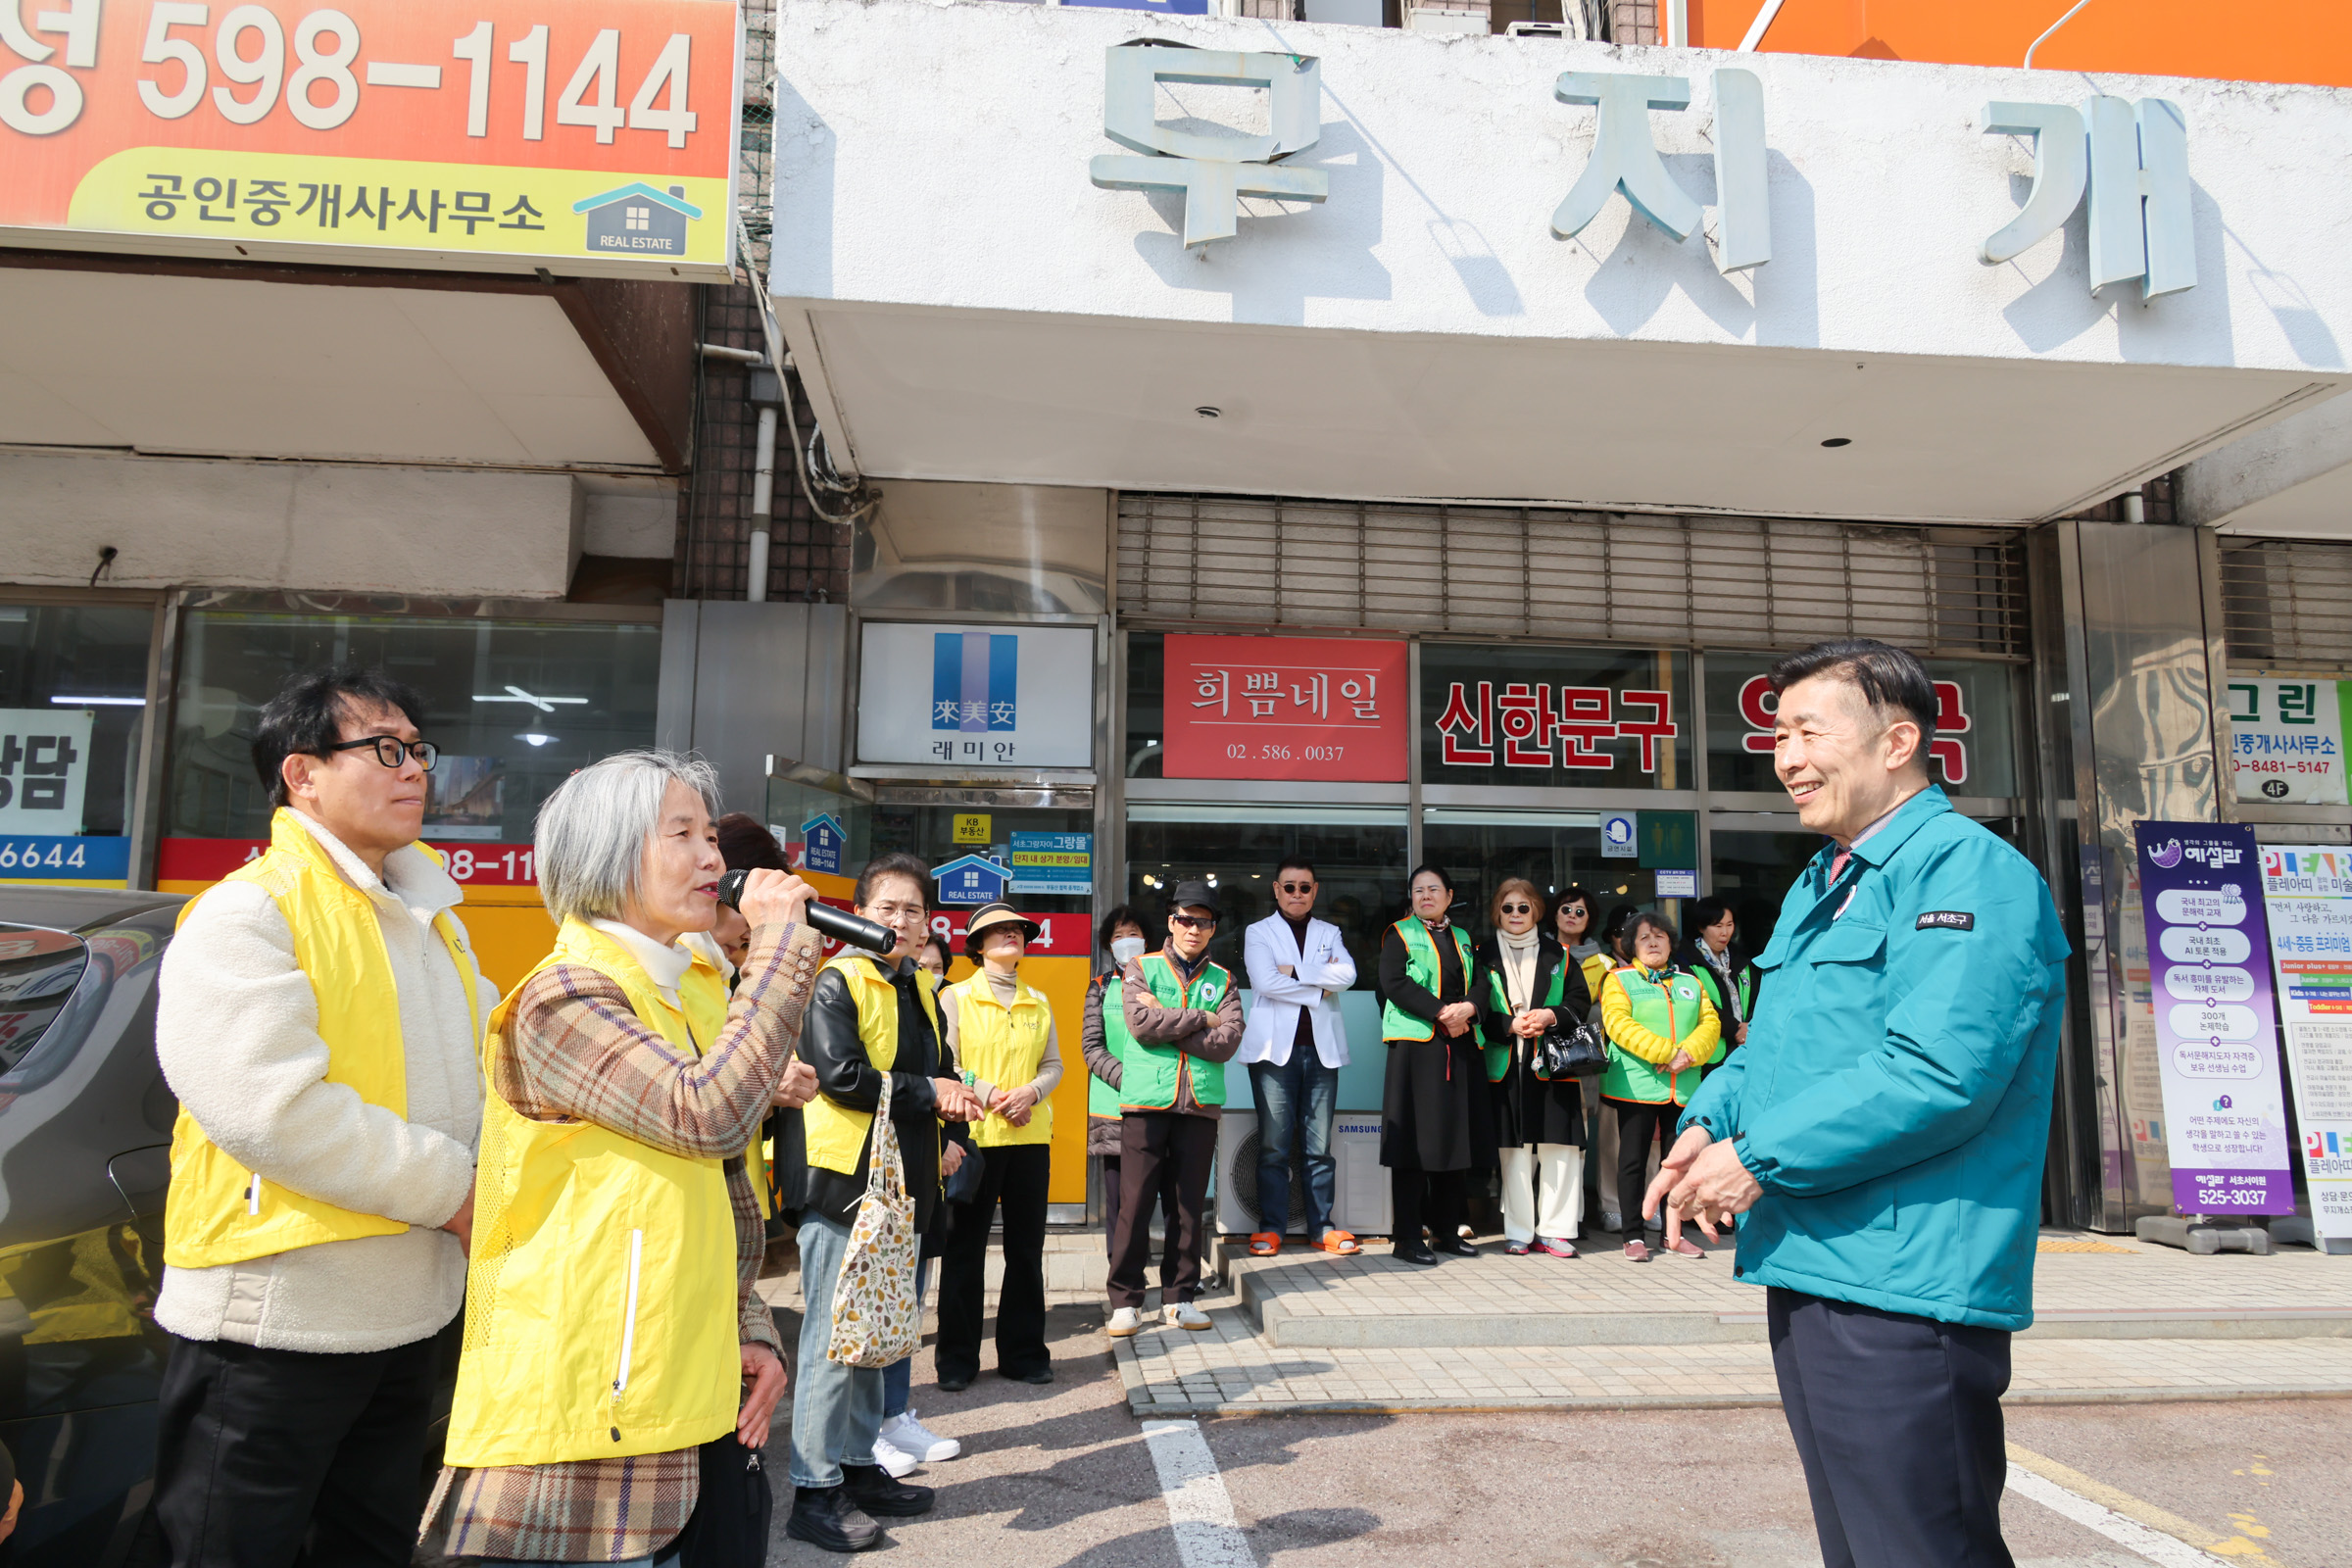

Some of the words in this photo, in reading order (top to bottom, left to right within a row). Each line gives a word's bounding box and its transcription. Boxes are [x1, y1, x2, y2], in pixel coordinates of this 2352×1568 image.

[136, 1, 698, 149] 598-1144
[1089, 43, 2197, 300] 무지개
[137, 172, 546, 235] 공인중개사사무소
[600, 235, 630, 248] REAL
[632, 237, 673, 250] ESTATE
[1191, 669, 1381, 720] 희쁨네일
[2228, 684, 2316, 724] 그린
[934, 700, 1016, 724] 來美安
[1436, 681, 1678, 773] 신한문구
[932, 741, 1016, 762] 래미안
[2267, 782, 2284, 796] 4F
[960, 827, 985, 837] 부동산
[1012, 840, 1054, 849] 서초그랑자이
[1054, 836, 1087, 851] 그랑몰
[810, 846, 822, 857] REAL
[821, 848, 836, 859] ESTATE
[811, 857, 835, 869] 598-1144
[1014, 855, 1029, 863] 단지
[1030, 855, 1038, 863] 내
[1056, 856, 1088, 864] 분양/임대
[2267, 877, 2314, 893] 플레아띠
[948, 891, 966, 900] REAL
[2180, 897, 2196, 906] 국내
[2197, 898, 2221, 906] 최고의
[2181, 907, 2205, 917] 문해력
[2206, 908, 2222, 917] 교재
[1919, 914, 1936, 924] 서울
[1936, 912, 1968, 925] 서초구
[2302, 913, 2320, 924] 다음
[2188, 936, 2204, 946] 국내
[2205, 936, 2222, 946] 최초
[2195, 947, 2210, 956] 토론
[2212, 947, 2227, 956] 적용
[2174, 973, 2188, 983] 독서
[2190, 974, 2213, 984] 흥미를
[2214, 975, 2245, 985] 유발하는
[2193, 985, 2209, 994] 자체
[2201, 1011, 2227, 1021] 300개
[2199, 1022, 2230, 1032] 논제학습
[2232, 1052, 2256, 1061] 자격증
[2190, 1063, 2205, 1072] 보유
[2207, 1063, 2230, 1073] 선생님
[2231, 1064, 2246, 1073] 수업
[2189, 1116, 2204, 1125] 어떤
[2206, 1116, 2235, 1125] 주제에도
[2236, 1117, 2259, 1126] 자신의
[1338, 1125, 1383, 1134] SAMSUNG
[2185, 1130, 2208, 1139] 생각을
[2209, 1130, 2231, 1140] 말하고
[2242, 1131, 2250, 1140] 수
[2251, 1131, 2267, 1141] 있는
[2192, 1144, 2223, 1152] 학생으로
[2224, 1144, 2264, 1153] 성장합니다!
[2198, 1189, 2268, 1205] 525-3037
